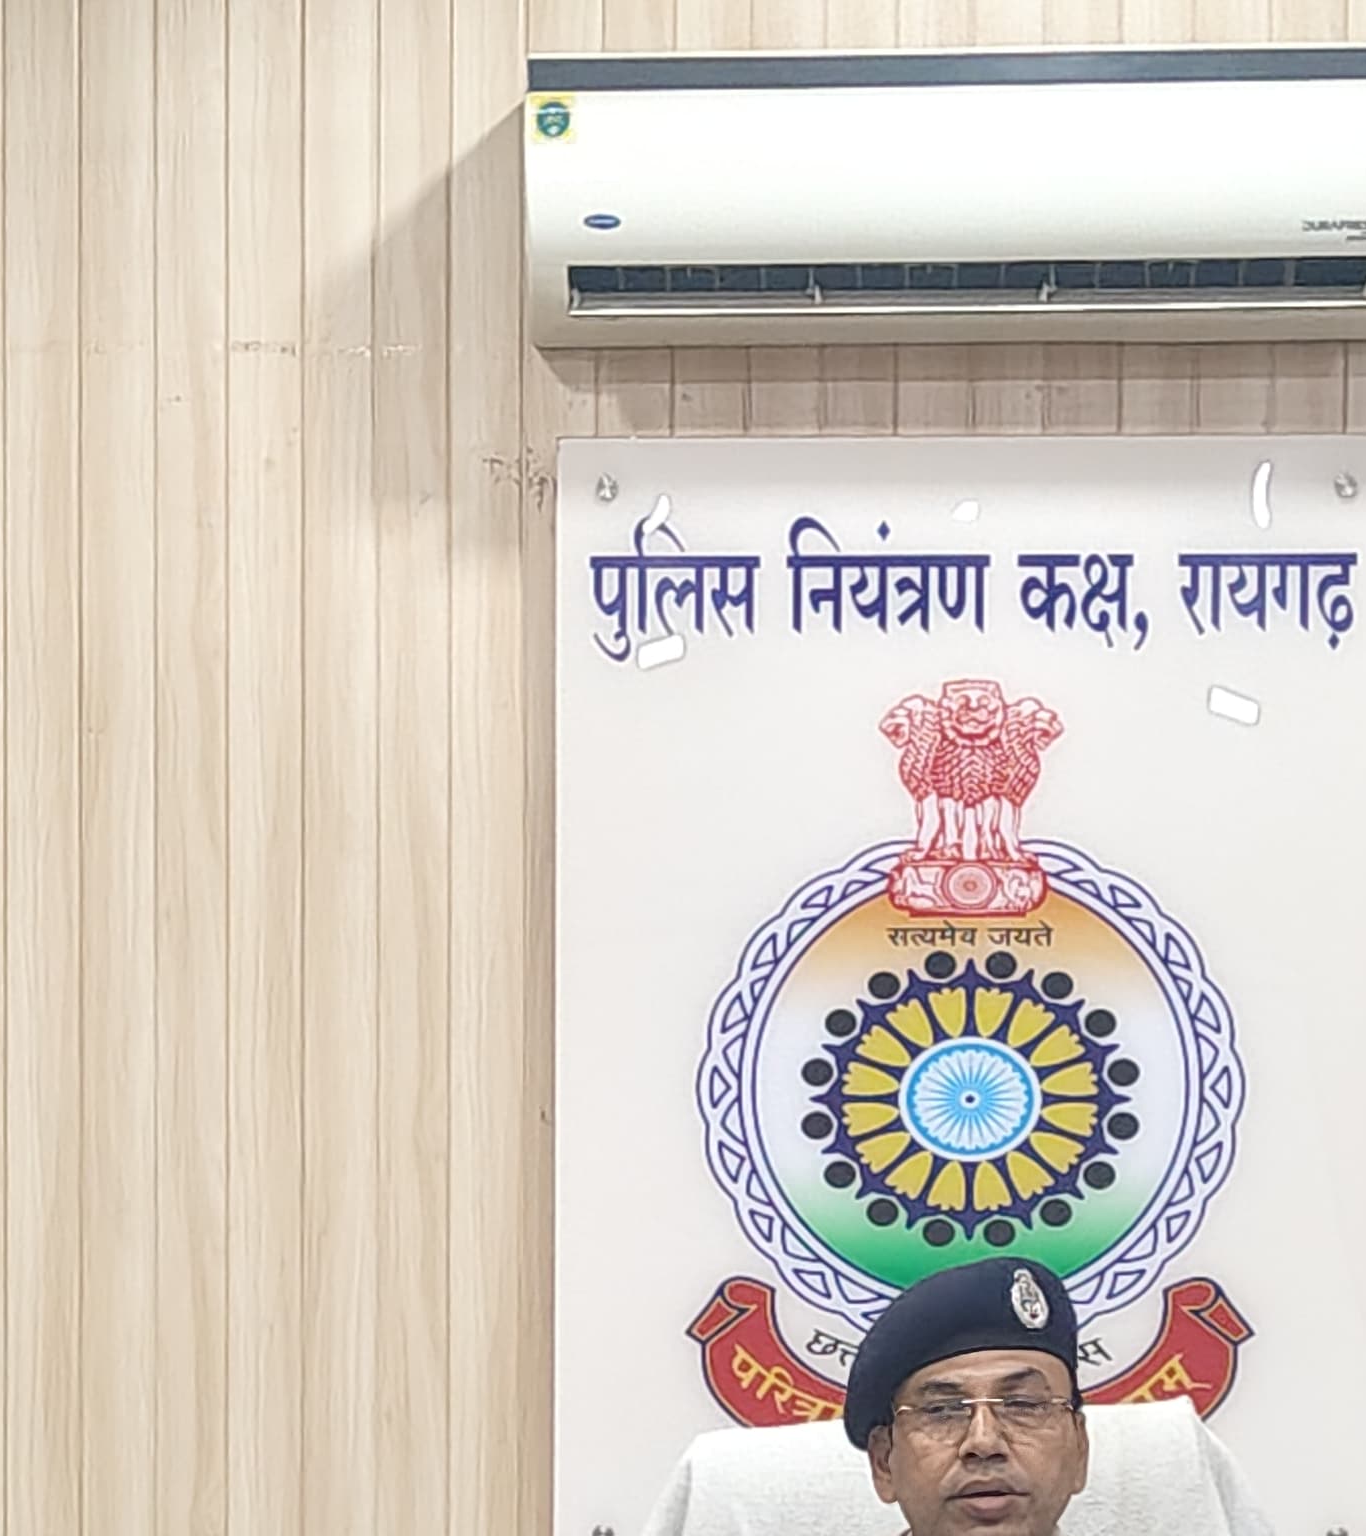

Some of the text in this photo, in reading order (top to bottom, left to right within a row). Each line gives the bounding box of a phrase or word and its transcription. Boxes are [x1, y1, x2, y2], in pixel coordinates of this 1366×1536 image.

[590, 515, 1358, 662] पुलिस नियंत्रण कक्ष, रायगढ़
[885, 919, 1054, 946] सत्यमेव जयते
